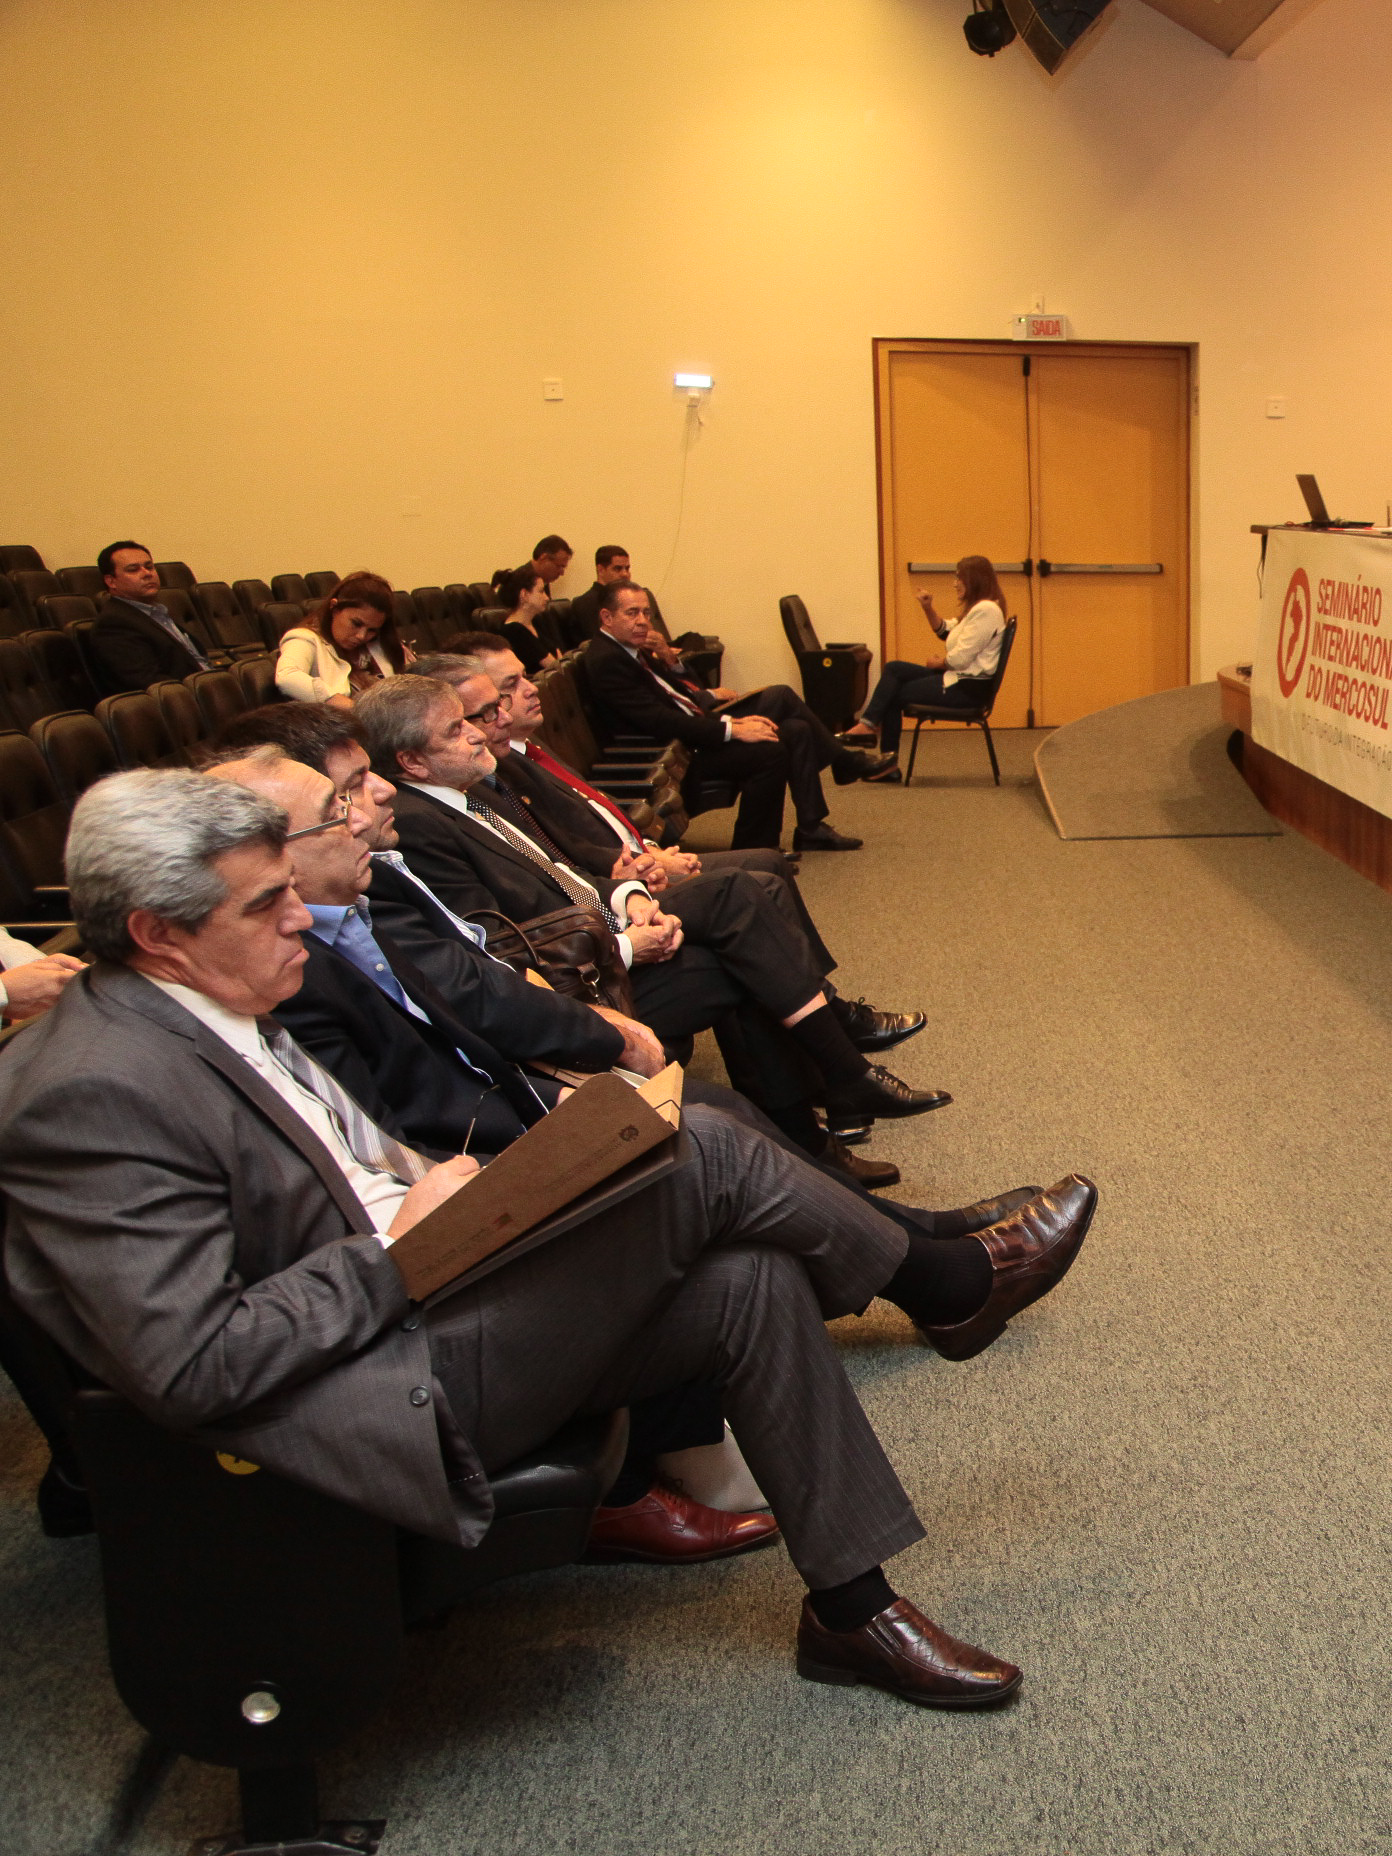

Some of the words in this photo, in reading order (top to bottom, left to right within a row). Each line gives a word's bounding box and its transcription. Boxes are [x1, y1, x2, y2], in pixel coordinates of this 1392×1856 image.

[1317, 574, 1382, 627] SEMINÁRIO
[1306, 664, 1322, 702] DO
[1323, 669, 1389, 730] MERCOSUL
